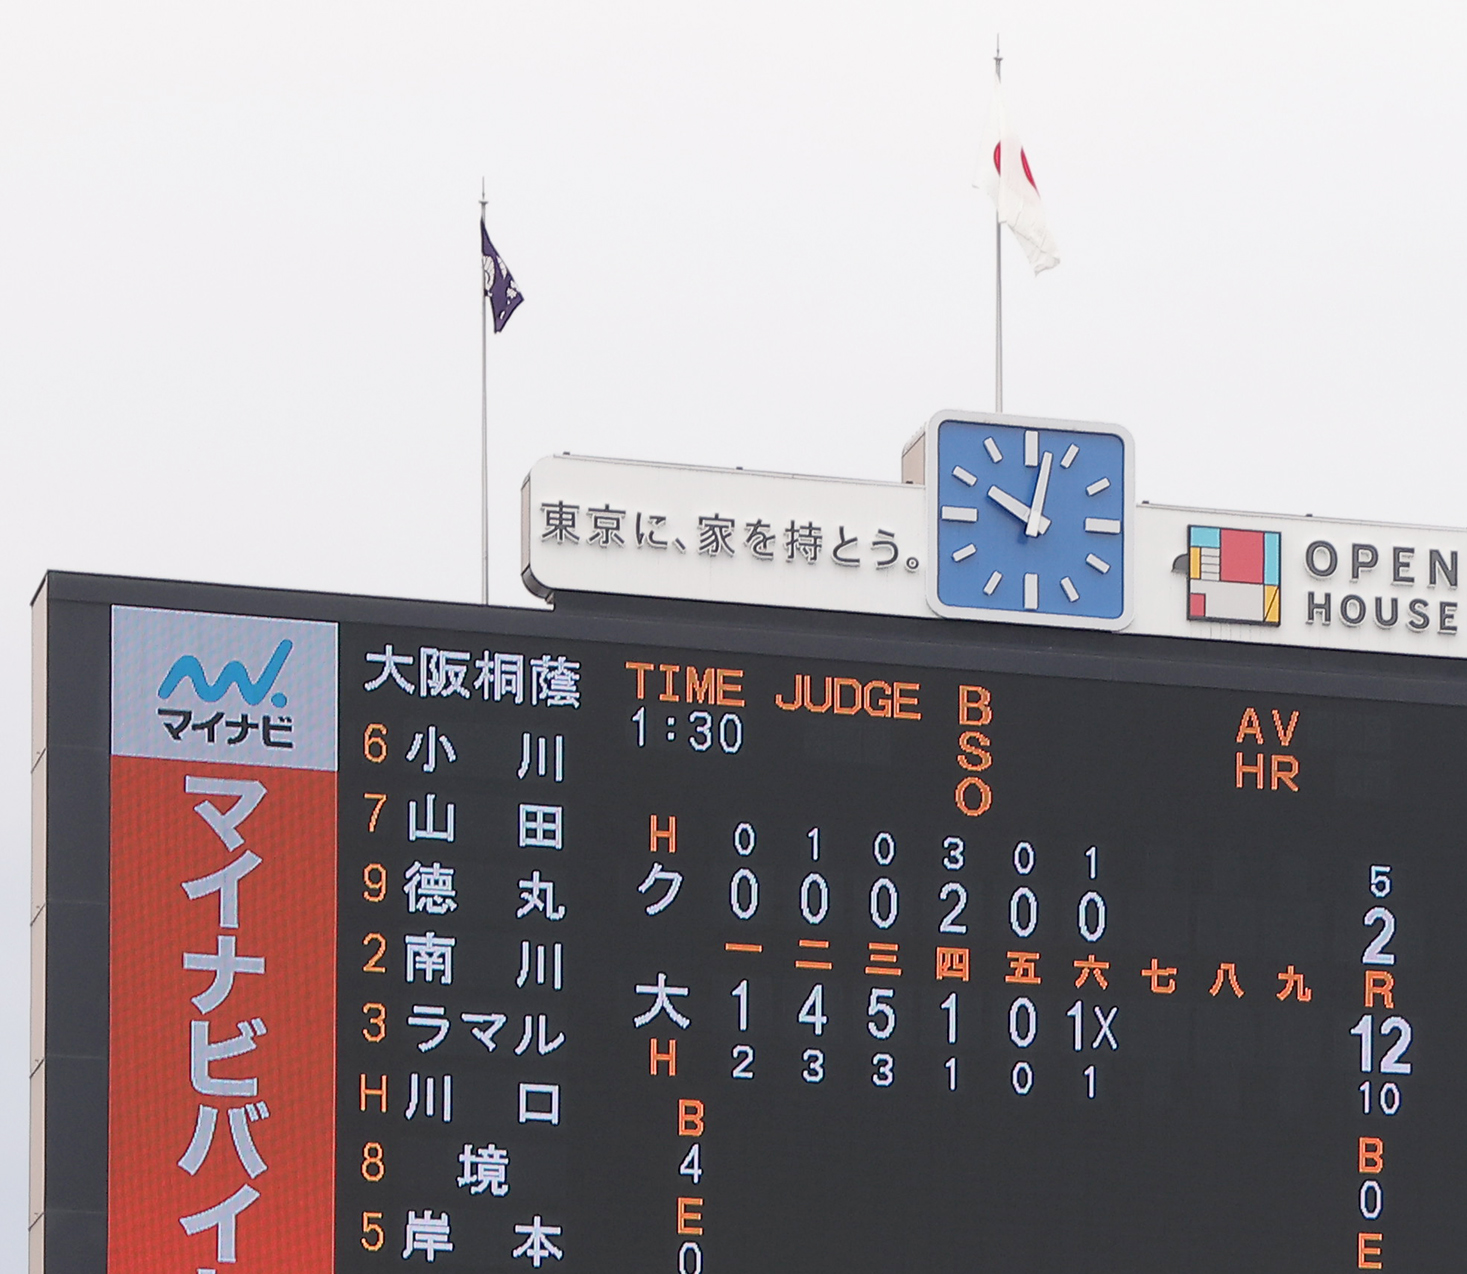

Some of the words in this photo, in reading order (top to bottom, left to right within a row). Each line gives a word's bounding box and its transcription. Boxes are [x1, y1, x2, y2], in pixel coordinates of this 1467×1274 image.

[540, 500, 921, 575] 東京に、家を持とう。
[1303, 541, 1462, 588] OPEN
[1304, 592, 1460, 635] HOUSE
[365, 645, 579, 708] 大阪桐蔭
[626, 662, 745, 707] TIME
[776, 675, 921, 720] JUDGE
[156, 706, 294, 750] マイナビ
[959, 685, 992, 726] B
[1237, 708, 1299, 746] AV
[365, 724, 386, 763] 6
[406, 726, 562, 781] 小川
[633, 707, 741, 753] 1:30
[958, 731, 991, 771] S
[1236, 752, 1298, 791] HR
[364, 793, 386, 832] 7
[409, 794, 562, 849] 山田
[651, 815, 675, 853] H
[735, 823, 754, 855] 0
[808, 828, 818, 860] 1
[875, 833, 894, 864] 0
[944, 837, 963, 869] 3
[1015, 842, 1034, 874] 0
[1086, 847, 1095, 878] 1
[364, 864, 386, 902] 9
[404, 861, 565, 920] 徳丸
[639, 863, 682, 915] ク
[731, 869, 758, 919] 0
[801, 873, 828, 924] 0
[871, 878, 897, 928] 0
[940, 883, 966, 933] 2
[1011, 887, 1037, 937] 0
[1079, 892, 1105, 941] 0
[1371, 866, 1390, 897] 5
[1363, 907, 1394, 964] 2
[363, 933, 385, 972] 2
[405, 932, 561, 989] 南川
[726, 943, 762, 952] 一
[795, 940, 832, 969] 二
[865, 943, 901, 976] 三
[936, 947, 969, 981] 四
[1005, 951, 1041, 984] 五
[1074, 955, 1109, 989] 六
[1141, 959, 1177, 993] 七
[1210, 963, 1244, 998] 八
[1277, 966, 1311, 1002] 九
[634, 973, 689, 1029] 大
[732, 980, 747, 1030] 1
[799, 985, 827, 1035] 4
[869, 988, 895, 1039] 5
[941, 993, 956, 1043] 1
[1010, 998, 1036, 1047] 0
[1067, 1001, 1117, 1050] 1X
[1365, 970, 1394, 1008] R
[363, 1003, 385, 1042] 3
[408, 1006, 564, 1055] ラマル
[1351, 1015, 1411, 1074] 12
[651, 1039, 676, 1076] H
[733, 1045, 753, 1078] 2
[803, 1049, 823, 1082] 3
[873, 1054, 893, 1086] 3
[946, 1058, 955, 1090] 1
[1013, 1062, 1032, 1094] 0
[1085, 1066, 1094, 1098] 1
[361, 1074, 386, 1112] H
[1360, 1082, 1399, 1114] 10
[679, 1099, 704, 1136] B
[362, 1142, 384, 1181] 8
[457, 1144, 508, 1196] 境
[680, 1144, 702, 1183] 4
[1359, 1137, 1383, 1173] B
[678, 1197, 703, 1235] E
[1361, 1181, 1381, 1219] 0
[362, 1212, 383, 1251] 5
[403, 1210, 562, 1267] 岸本
[1358, 1233, 1382, 1269] E
